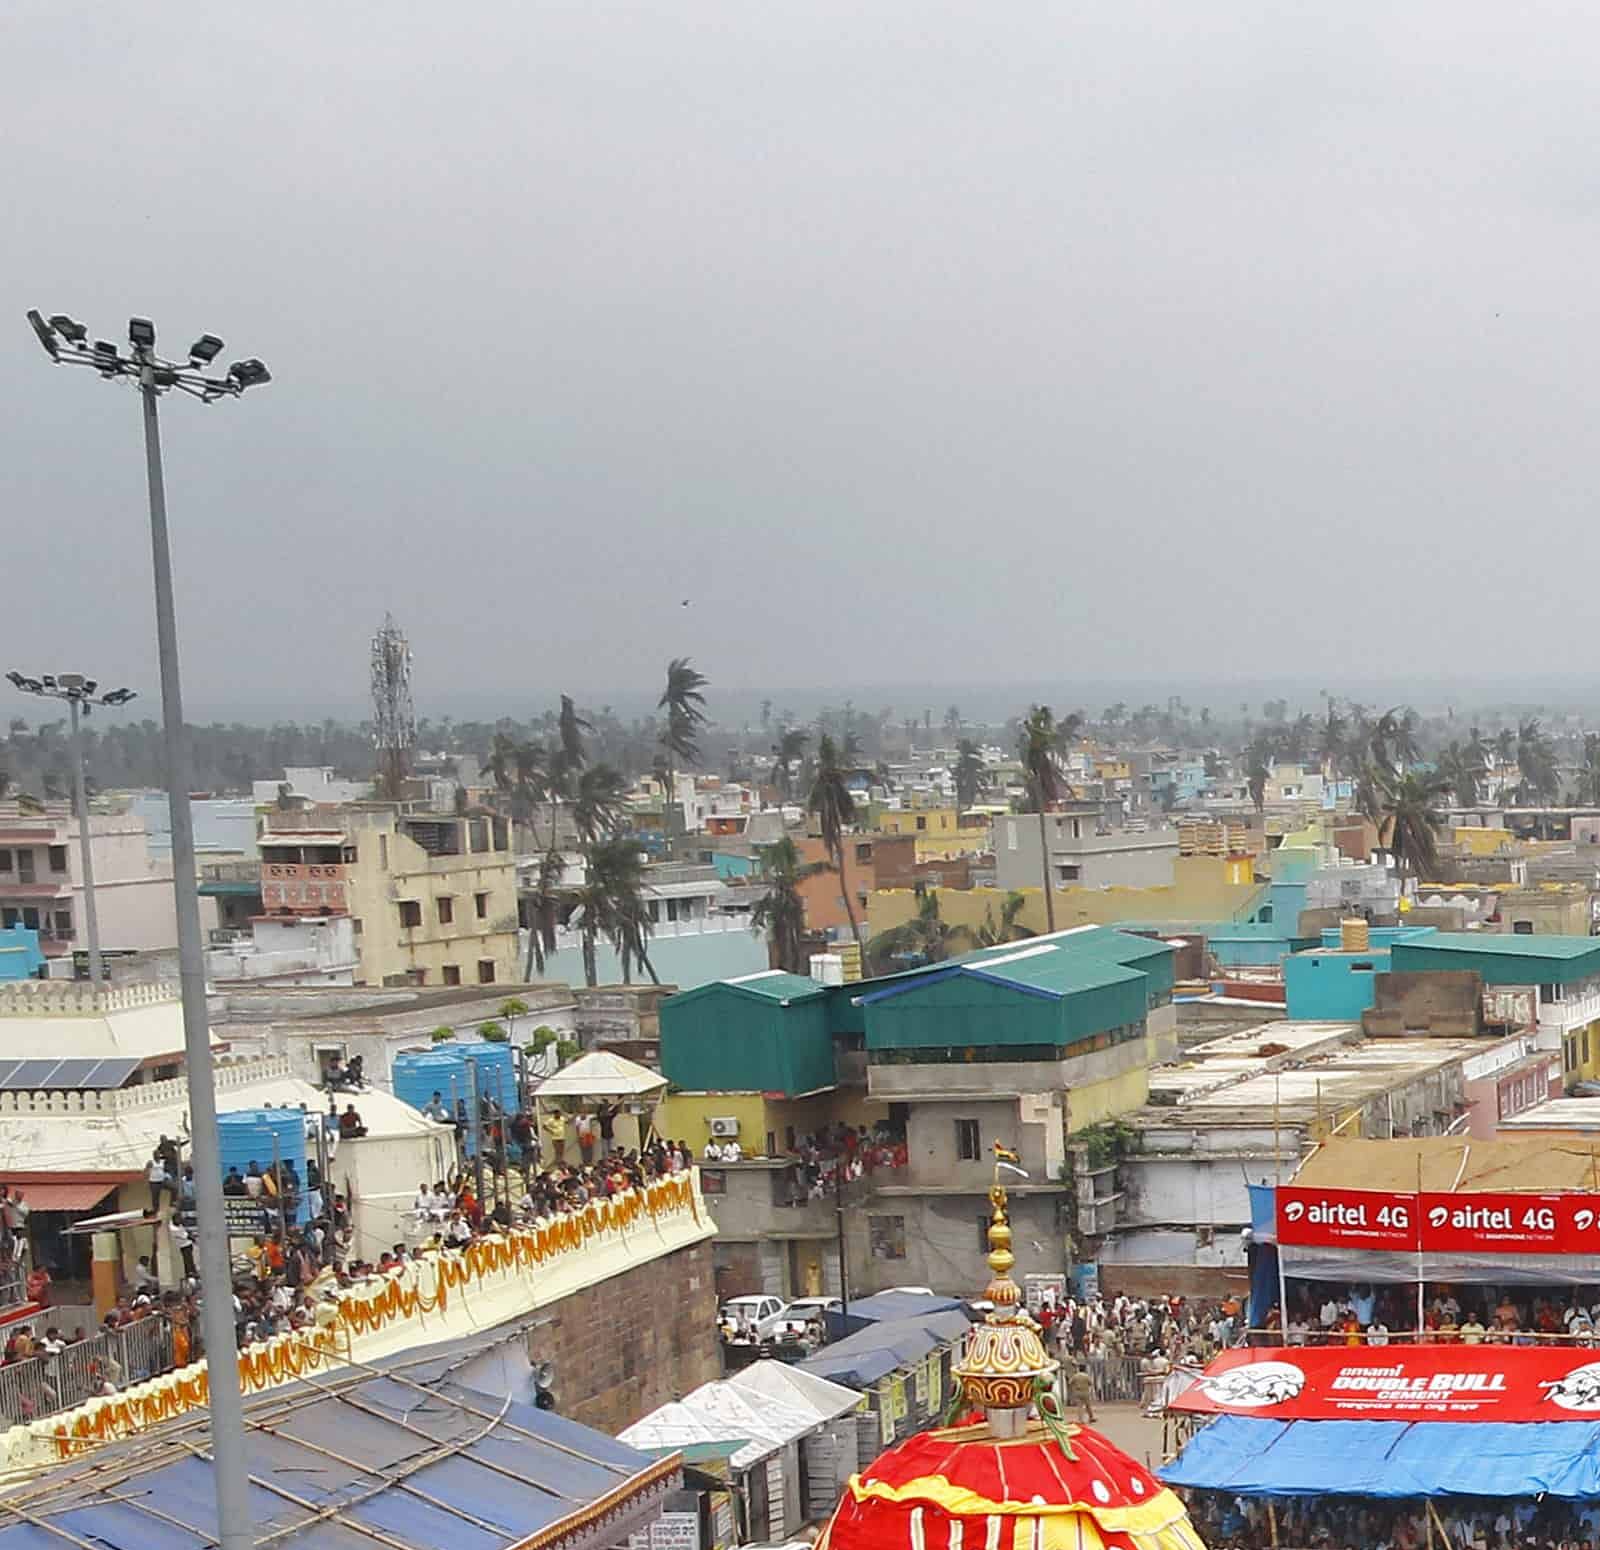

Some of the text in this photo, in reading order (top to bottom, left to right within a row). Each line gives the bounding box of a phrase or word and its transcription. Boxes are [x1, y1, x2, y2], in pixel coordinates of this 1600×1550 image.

[1308, 1201, 1367, 1226] airtel
[1376, 1206, 1409, 1228] 4G
[1452, 1206, 1512, 1230] airtel
[1522, 1209, 1555, 1230] 4G
[1332, 1373, 1507, 1391] DOUBLE BULL
[1377, 1391, 1453, 1400] CEMENT
